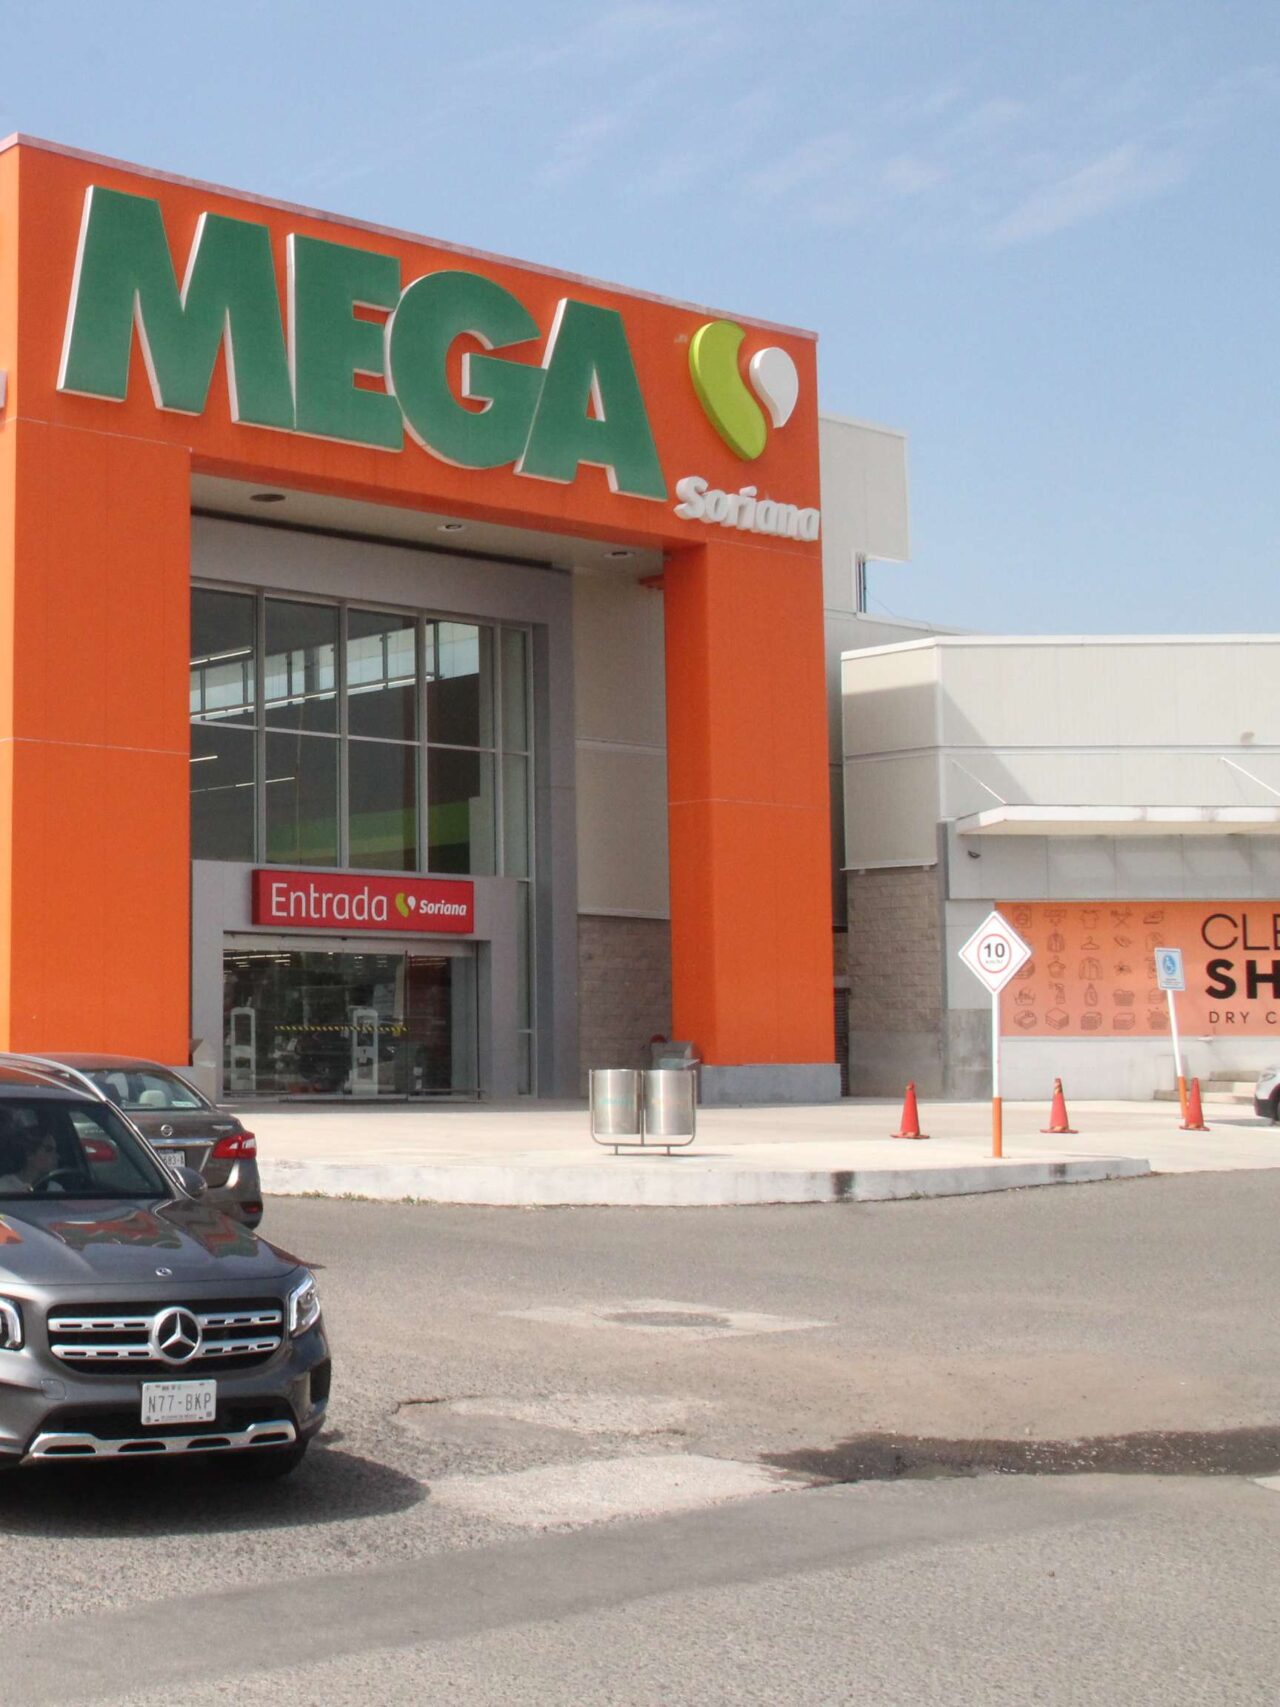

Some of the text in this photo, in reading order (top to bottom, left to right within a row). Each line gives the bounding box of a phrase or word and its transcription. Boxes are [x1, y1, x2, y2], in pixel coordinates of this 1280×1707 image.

[56, 184, 668, 503] MEGA
[673, 476, 820, 542] Soriana
[272, 883, 467, 922] Entrada Soriana
[984, 943, 1005, 958] 10
[1205, 958, 1280, 999] SH
[1209, 1011, 1250, 1024] DRY
